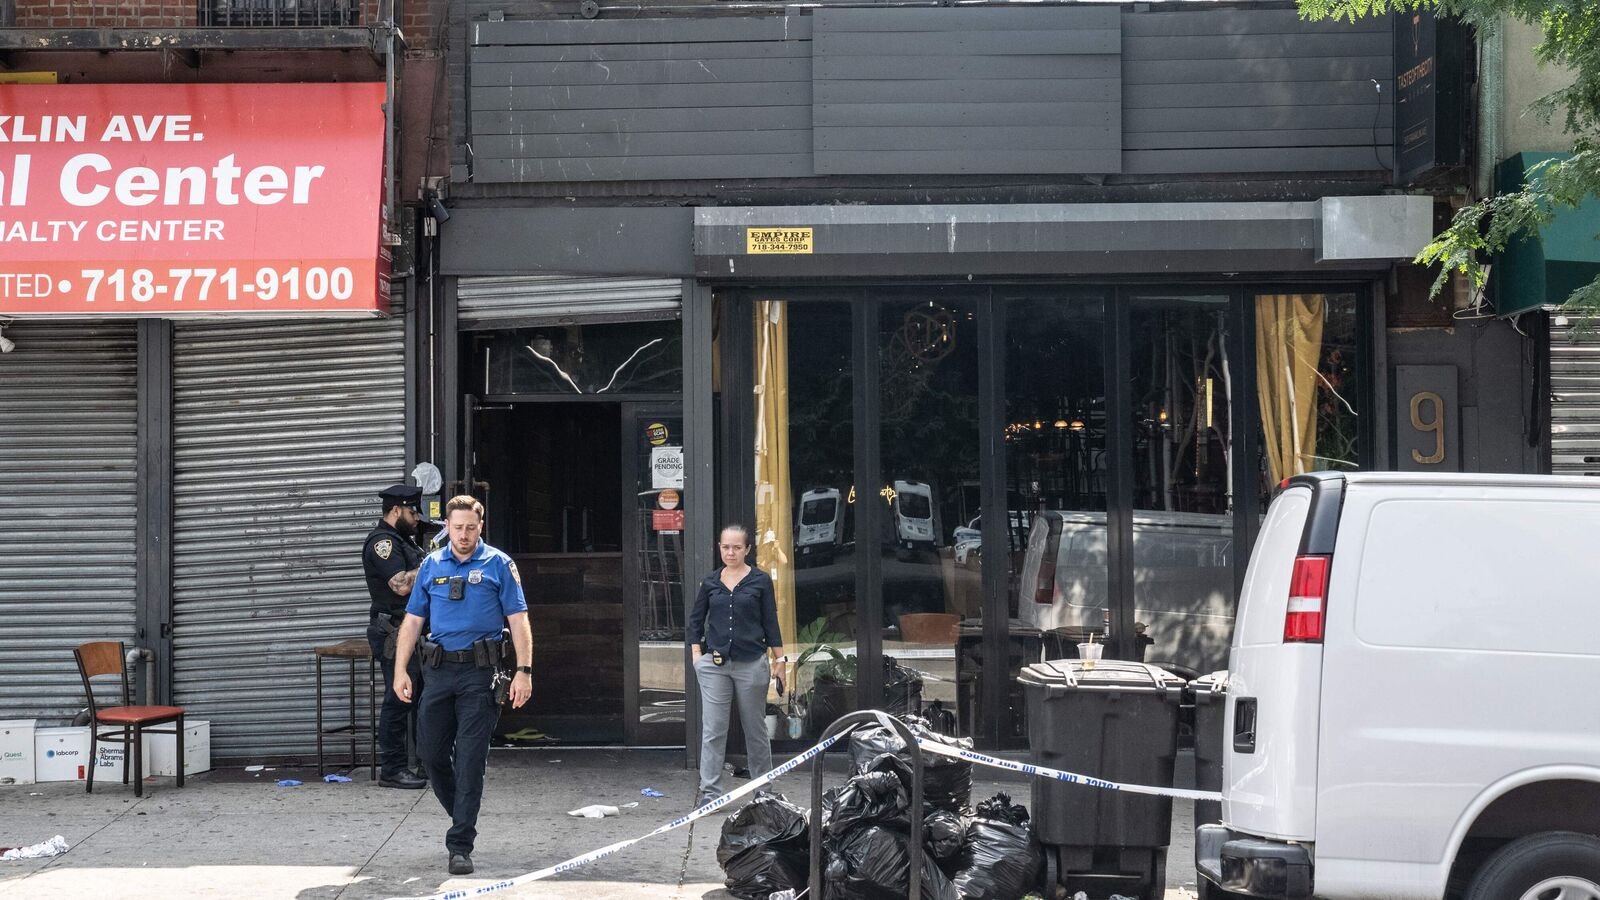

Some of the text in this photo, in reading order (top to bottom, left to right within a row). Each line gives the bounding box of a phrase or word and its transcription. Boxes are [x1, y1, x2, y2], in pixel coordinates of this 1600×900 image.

[100, 115, 204, 142] AVE.
[59, 153, 326, 207] Center
[96, 219, 225, 242] CENTER
[0, 273, 53, 298] TED
[81, 266, 354, 302] 718-771-9100
[1410, 391, 1445, 464] 9
[99, 760, 115, 768] Labs
[1056, 771, 1078, 783] LINE
